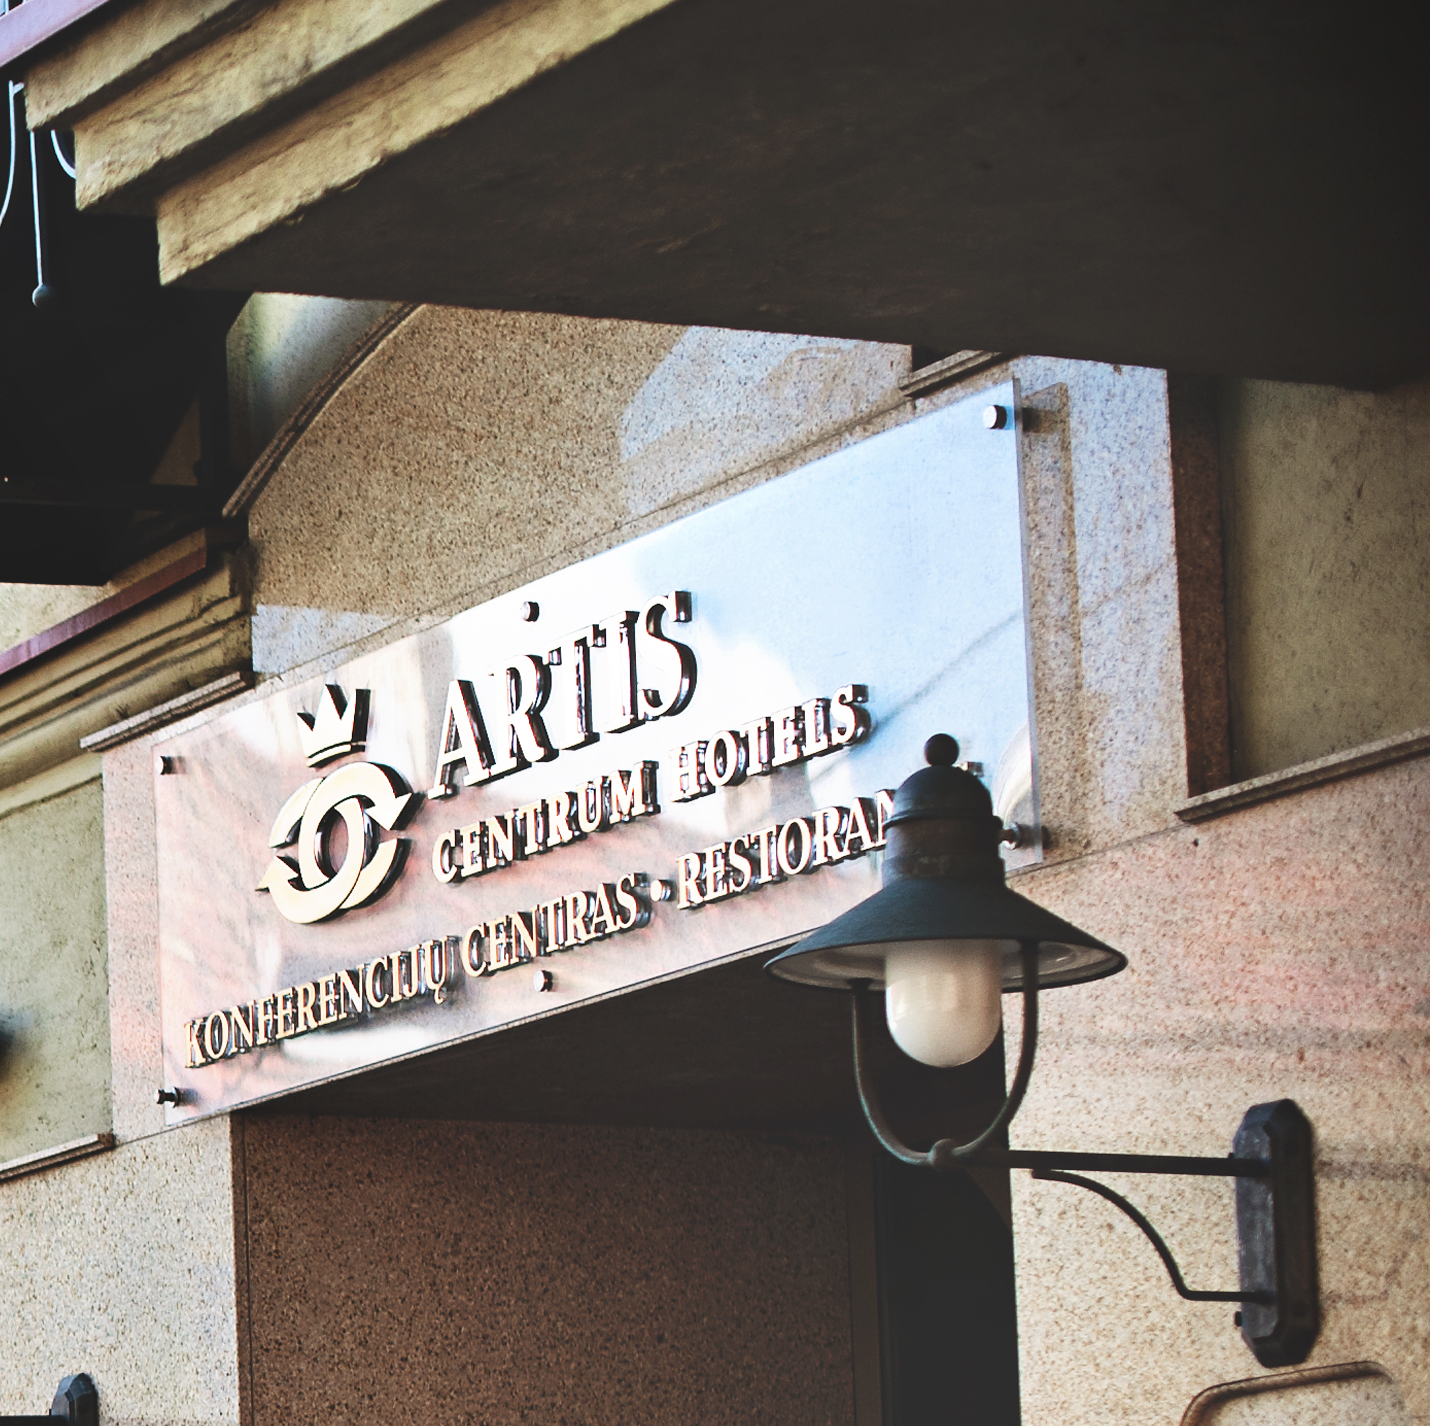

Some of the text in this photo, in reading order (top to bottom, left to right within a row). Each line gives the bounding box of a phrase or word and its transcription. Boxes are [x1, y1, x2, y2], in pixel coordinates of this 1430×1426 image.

[428, 590, 697, 799] ARTIS
[432, 684, 871, 884] CENTRUM HOTELS
[184, 935, 460, 1068] KONFERENCIJŲ
[461, 873, 653, 978] CENTRAS
